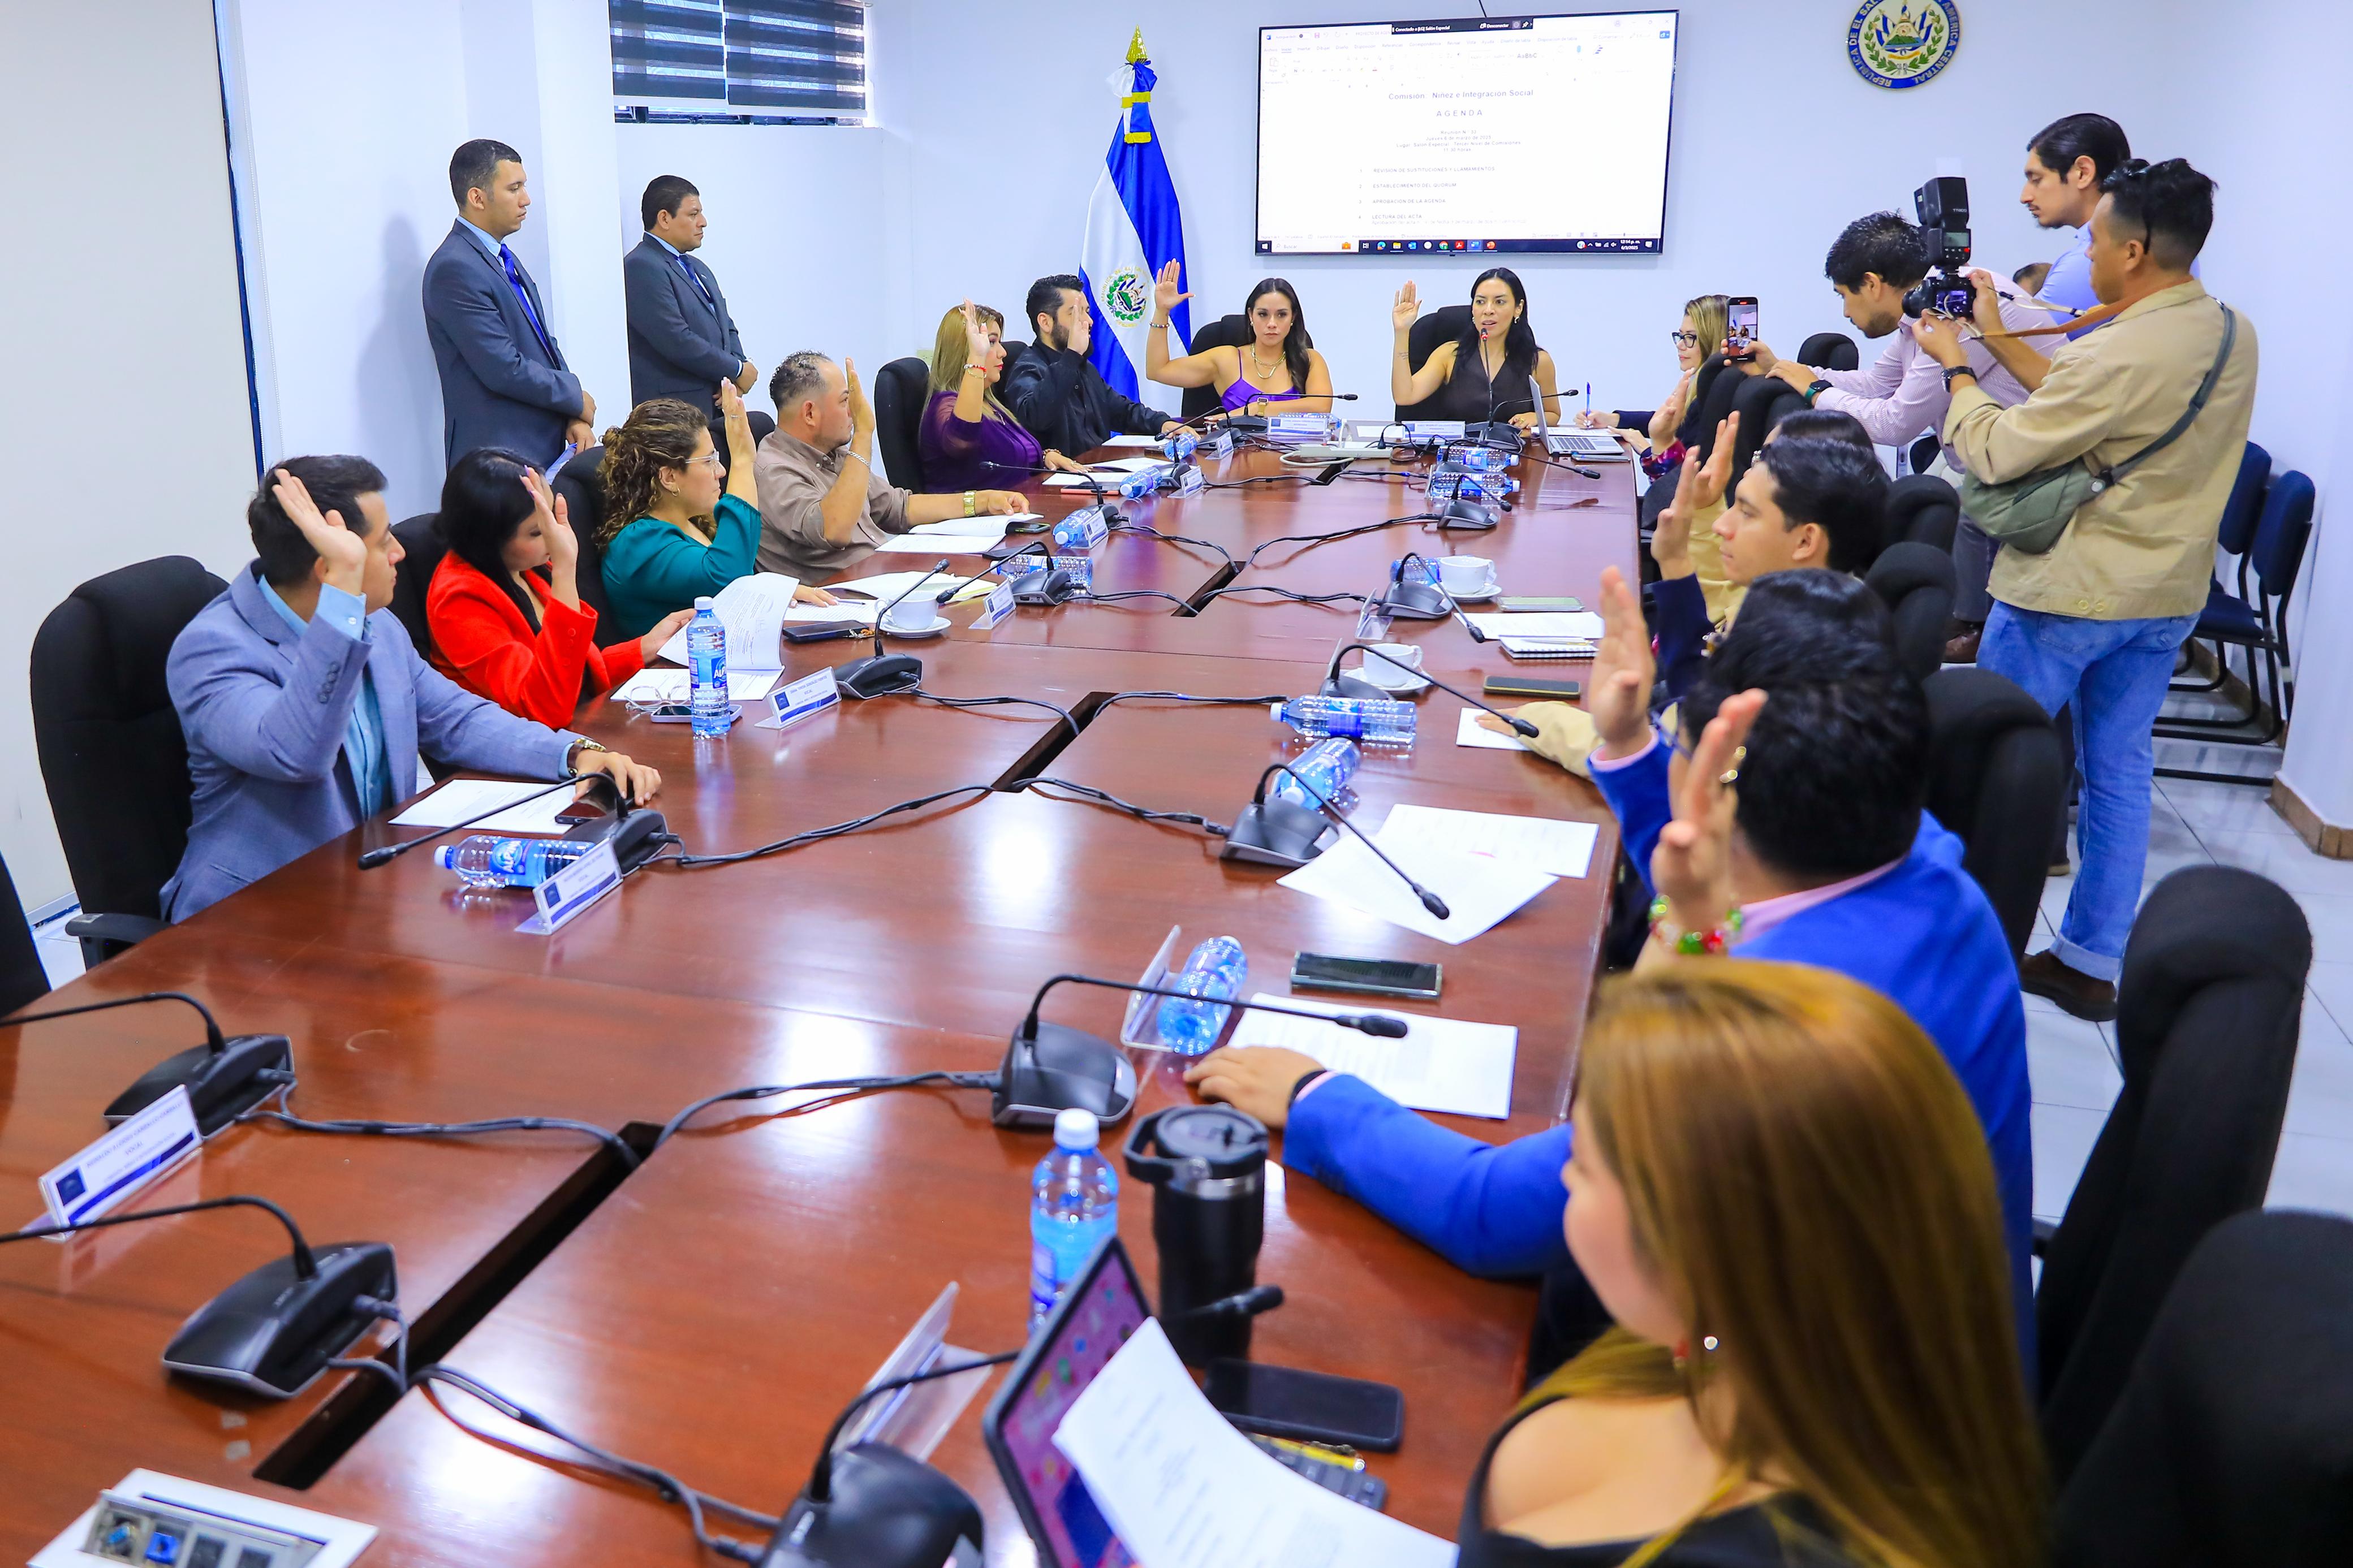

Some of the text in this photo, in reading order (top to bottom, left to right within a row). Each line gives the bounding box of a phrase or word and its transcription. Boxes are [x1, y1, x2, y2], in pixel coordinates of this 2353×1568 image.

[1853, 19, 1863, 29] EL
[1849, 32, 1858, 45] DE
[1912, 49, 1953, 84] CENTRAL
